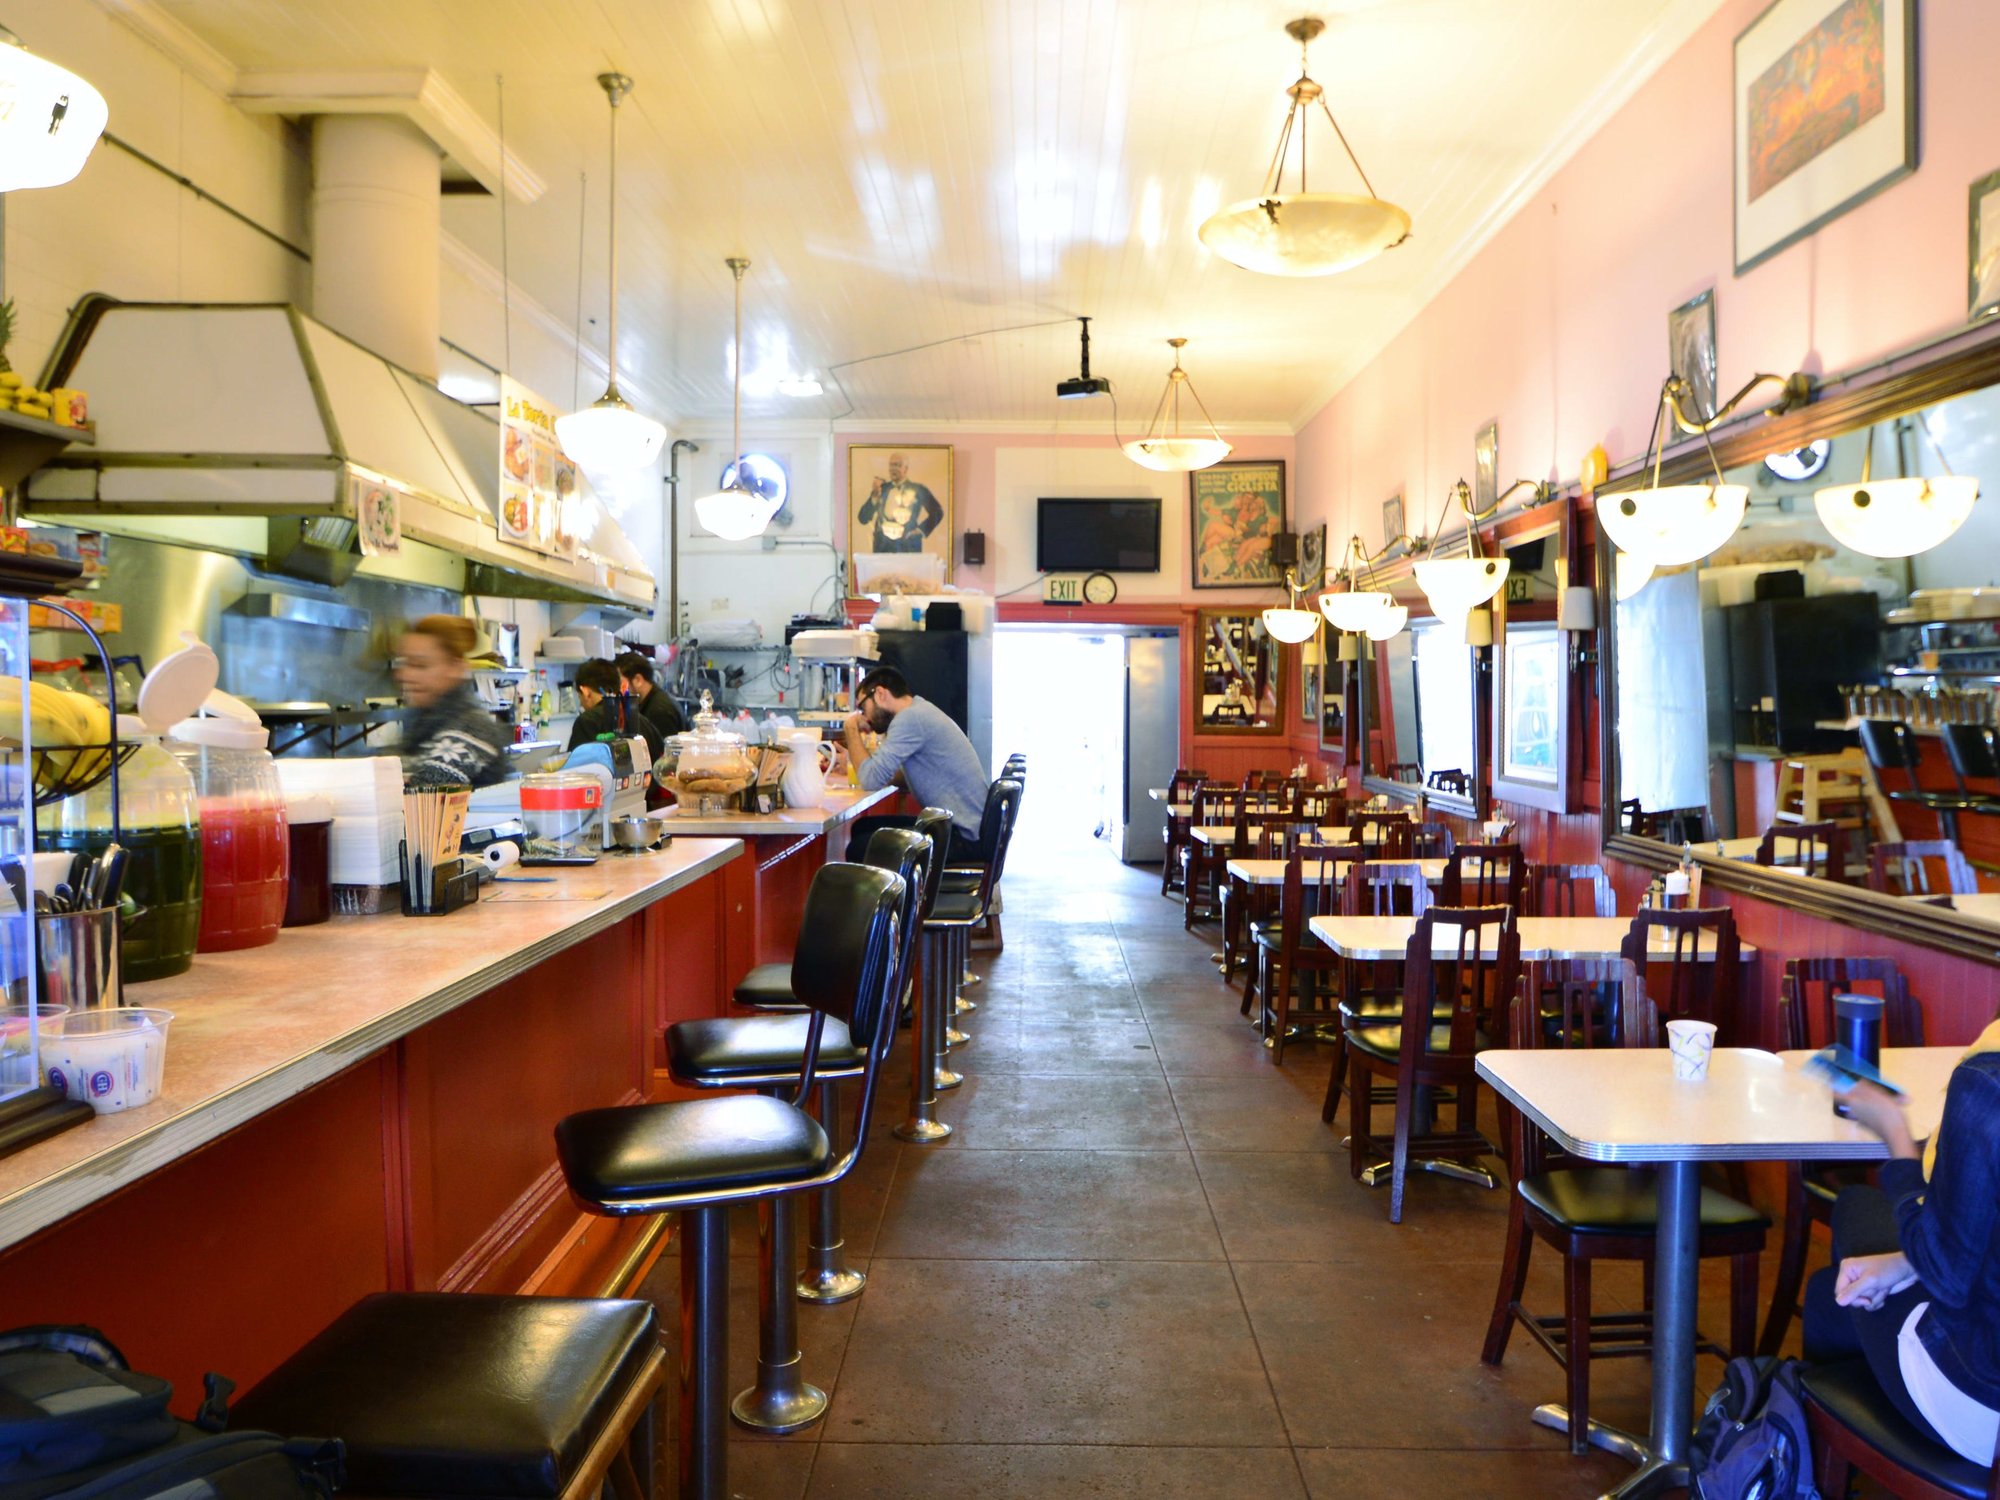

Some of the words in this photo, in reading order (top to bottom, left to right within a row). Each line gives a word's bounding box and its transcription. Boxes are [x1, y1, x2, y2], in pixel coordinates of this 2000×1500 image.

[507, 396, 520, 417] La
[522, 400, 549, 430] Torta
[1227, 481, 1278, 492] CICLISTA
[1050, 580, 1077, 600] EXIT
